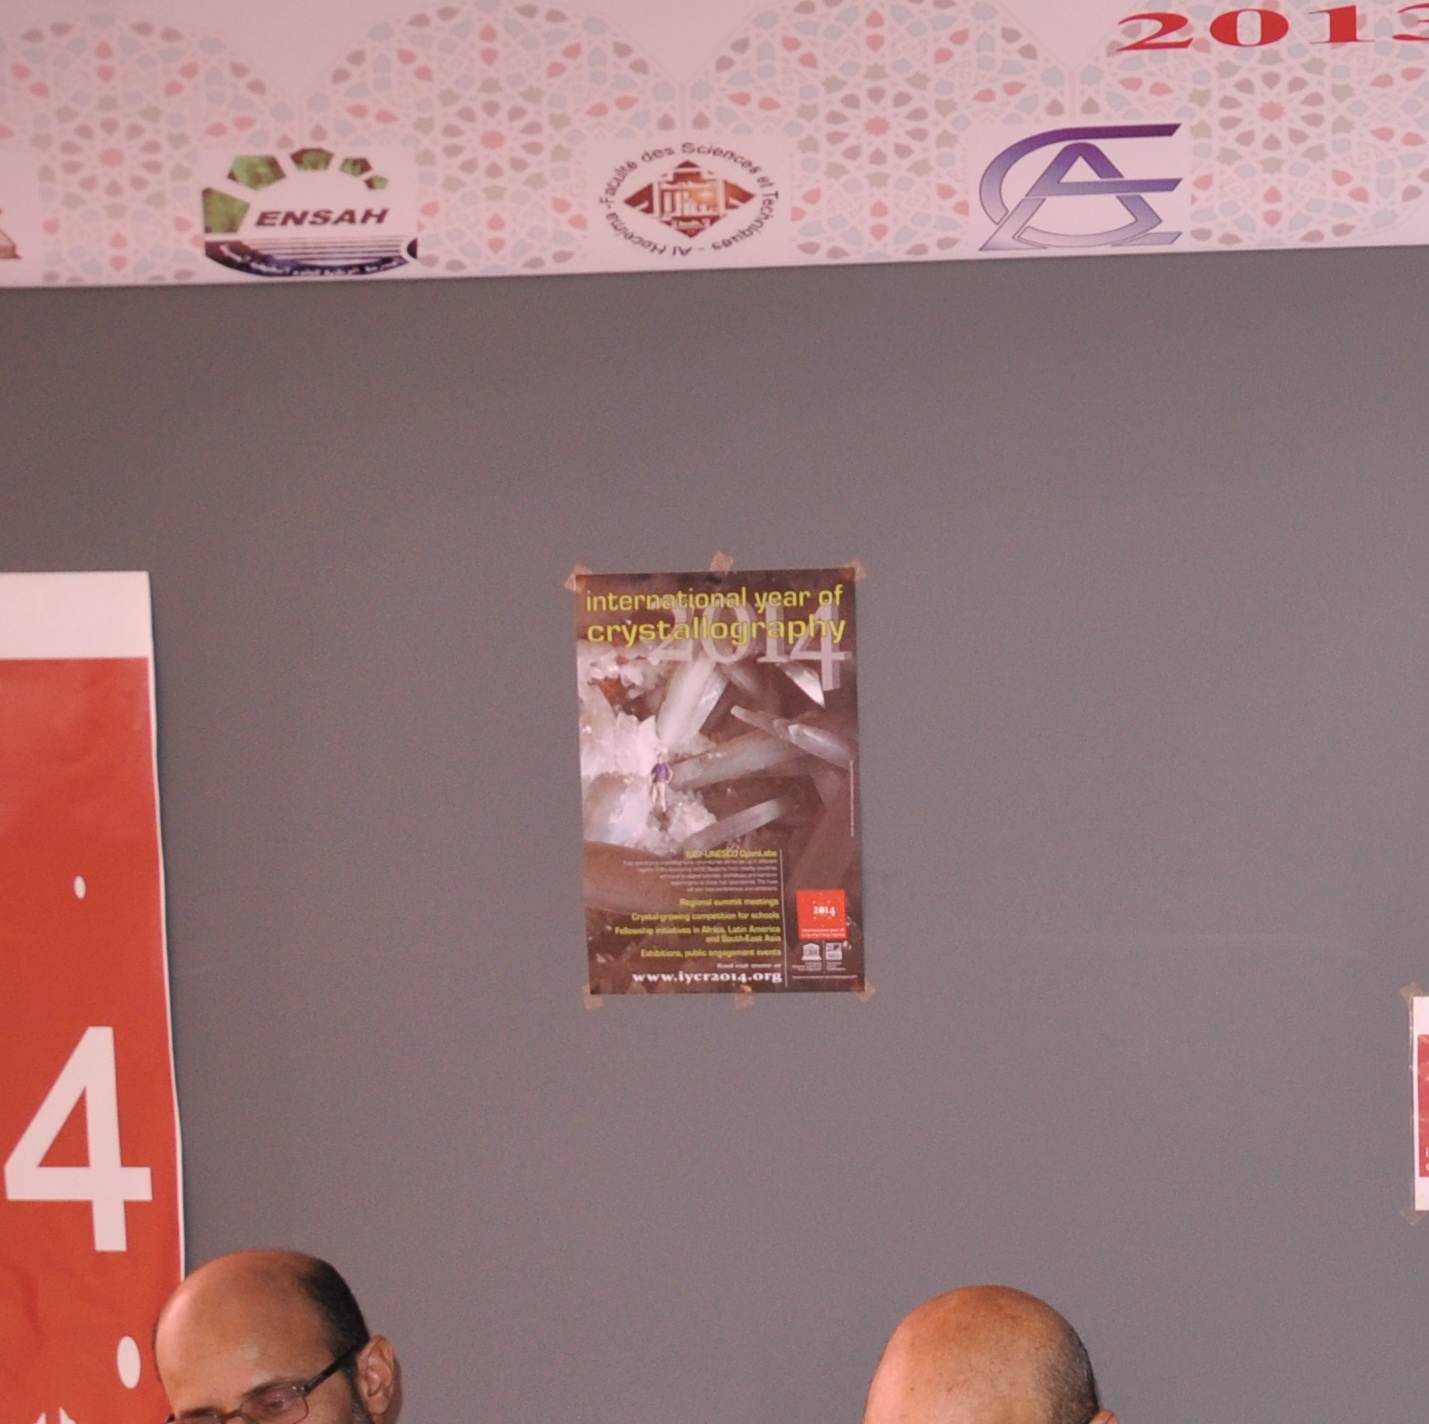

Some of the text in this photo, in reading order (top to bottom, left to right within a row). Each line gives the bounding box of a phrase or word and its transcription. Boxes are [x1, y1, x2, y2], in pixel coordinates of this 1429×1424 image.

[255, 207, 390, 228] ENSAH
[586, 584, 844, 613] international year of
[586, 613, 847, 648] crystallography
[631, 970, 783, 984] www.iycr2014.org
[4, 1026, 153, 1252] 4
